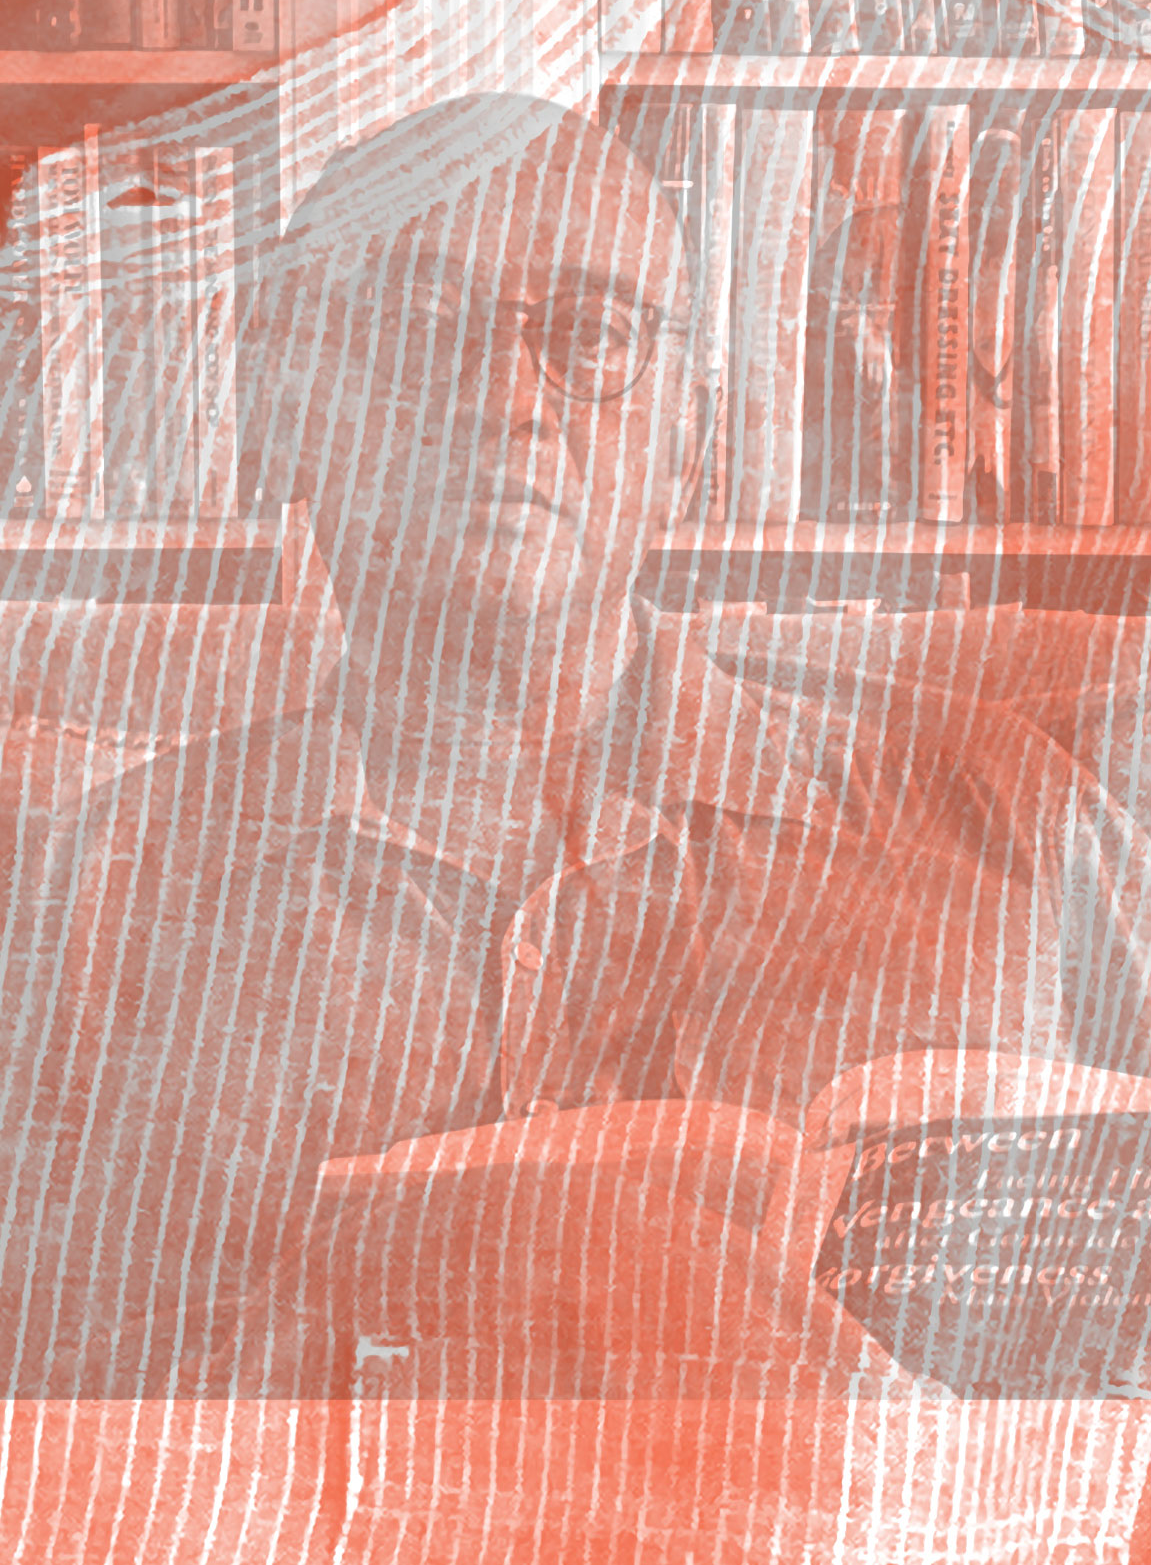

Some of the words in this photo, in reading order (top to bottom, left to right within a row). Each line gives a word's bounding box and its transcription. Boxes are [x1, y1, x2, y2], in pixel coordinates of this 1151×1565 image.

[935, 268, 959, 399] DRESSING
[851, 1128, 1081, 1182] Between
[833, 1198, 1116, 1239] Vengeance
